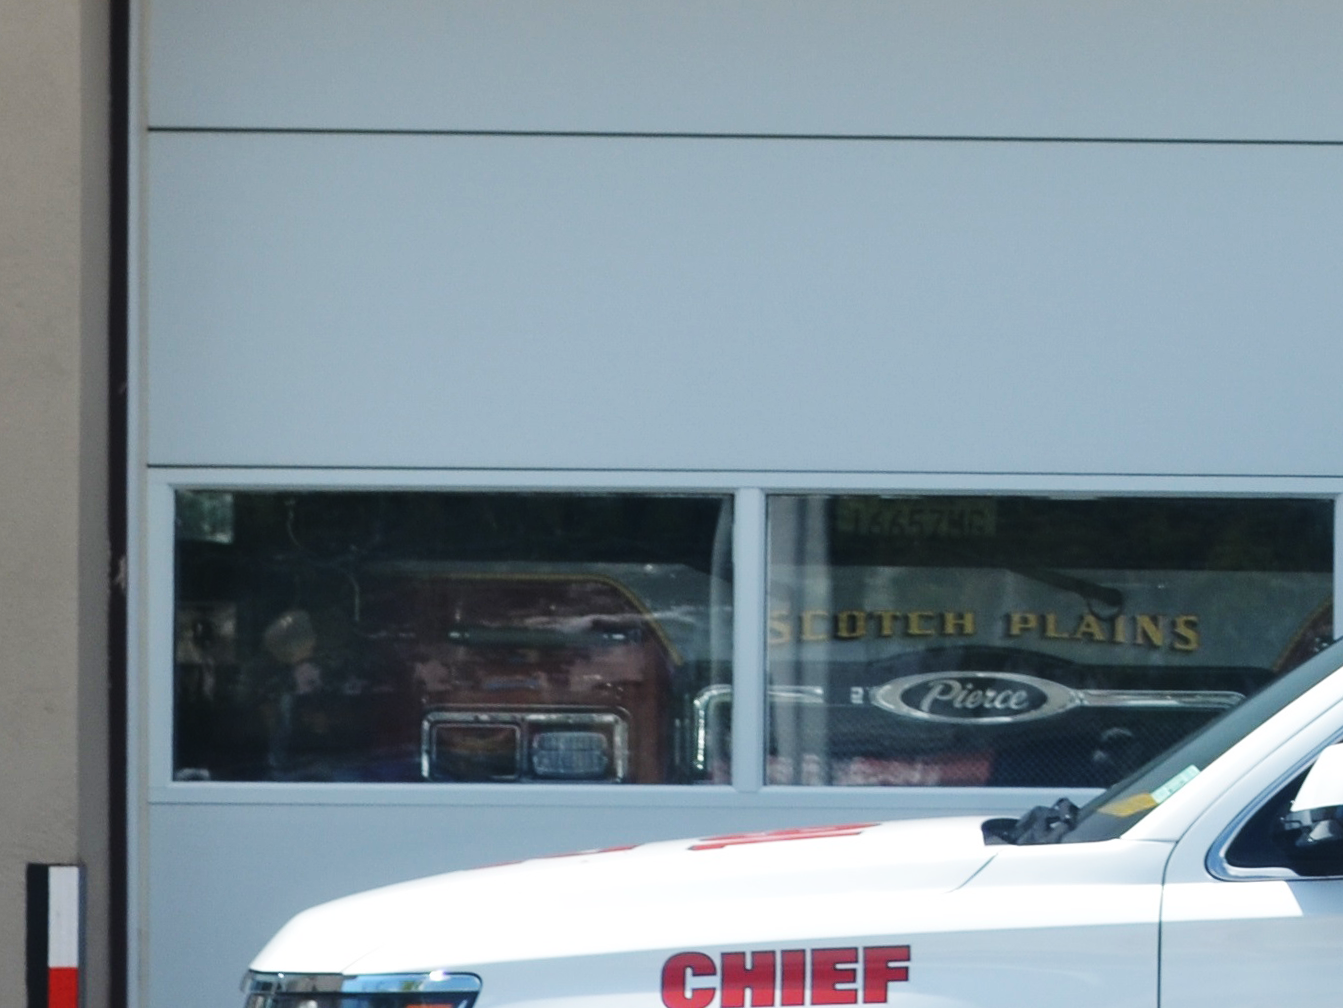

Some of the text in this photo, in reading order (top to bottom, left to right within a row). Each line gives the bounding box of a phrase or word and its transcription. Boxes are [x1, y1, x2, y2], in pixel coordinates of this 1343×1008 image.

[768, 608, 1202, 652] SCOTCH PLAINS
[920, 678, 1029, 712] Pierce
